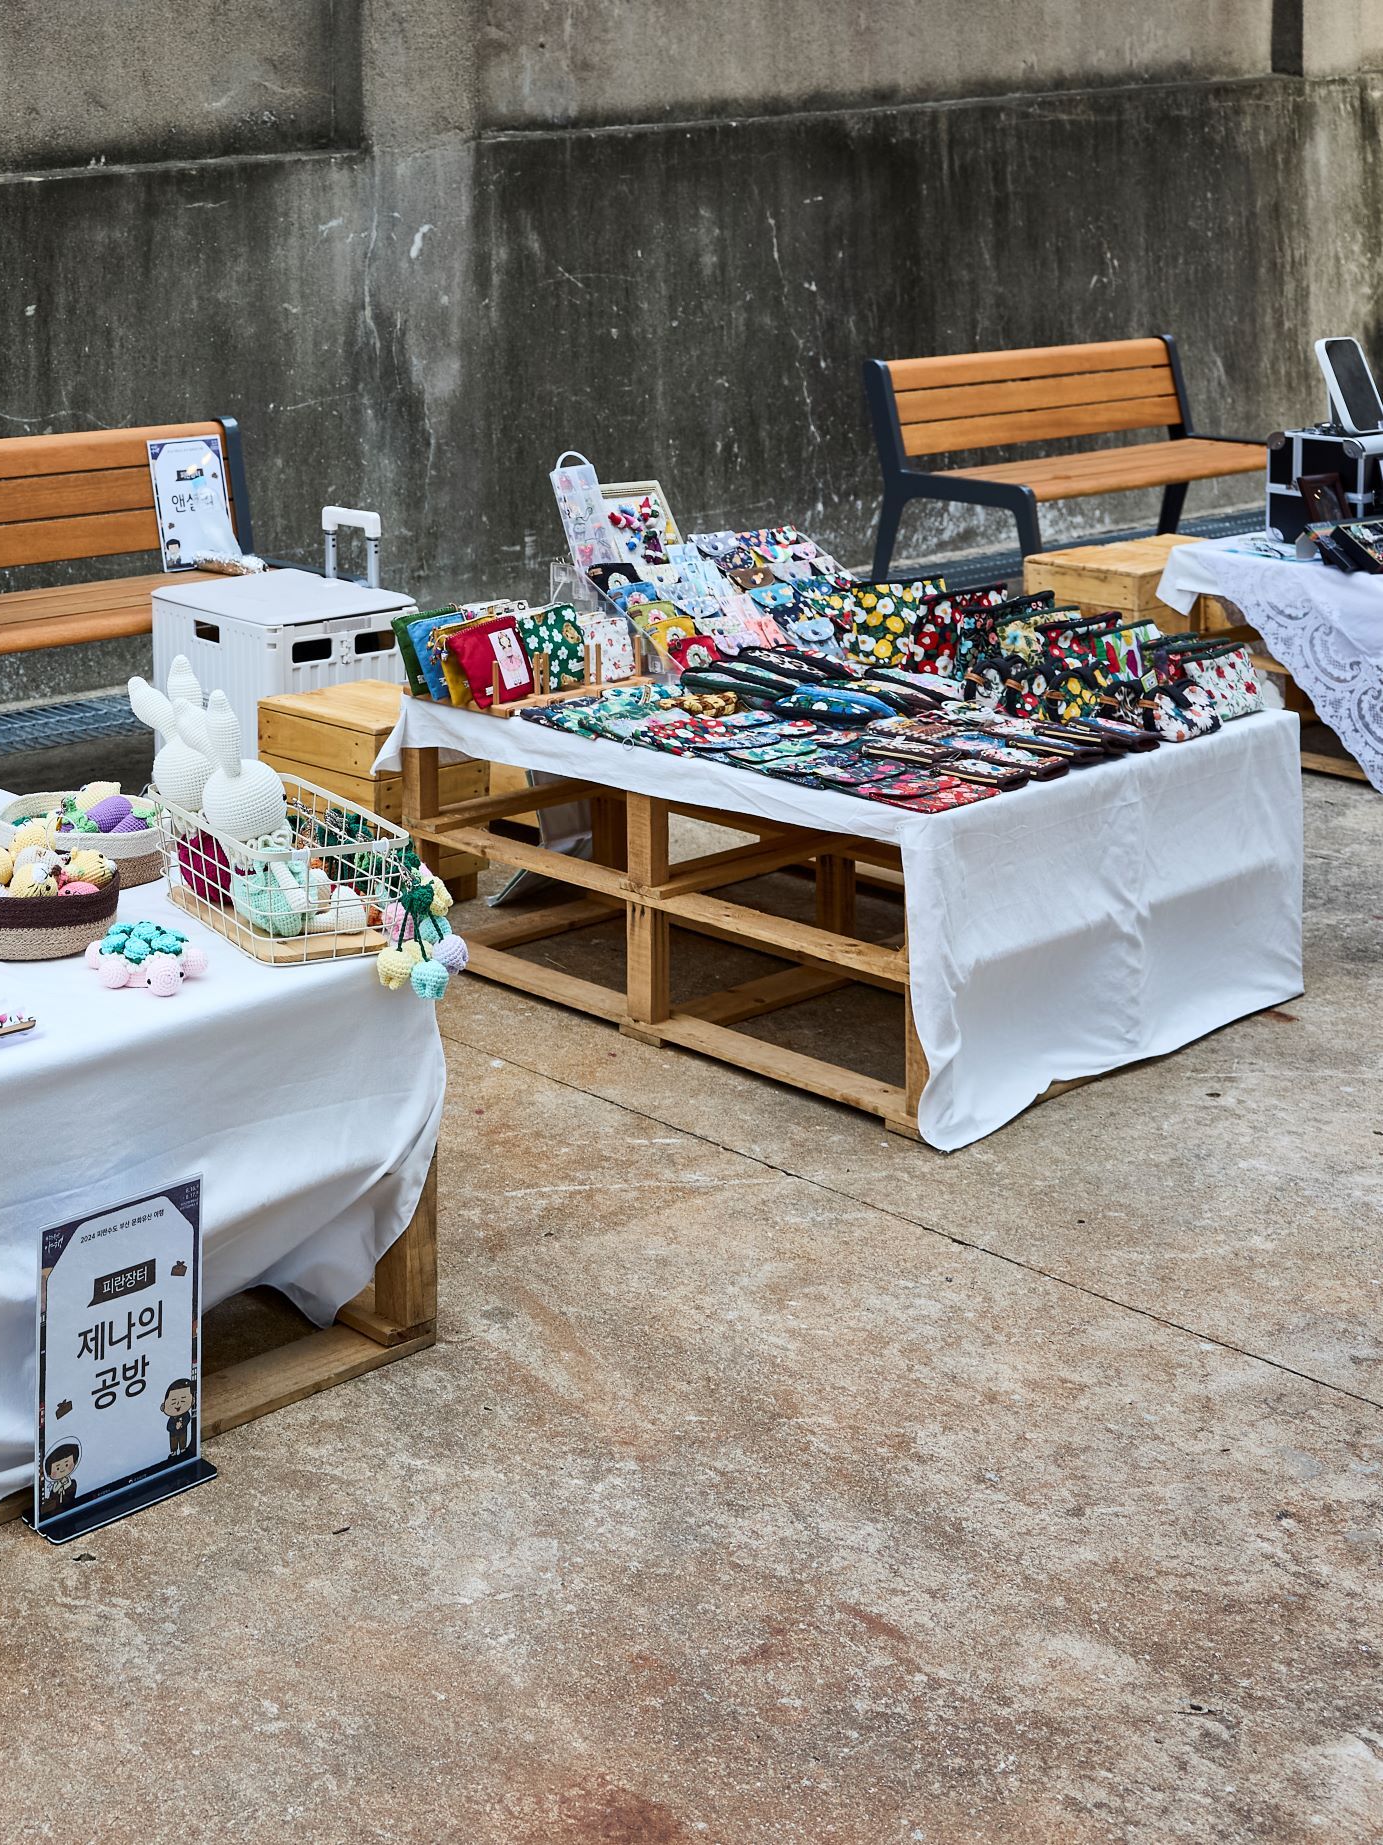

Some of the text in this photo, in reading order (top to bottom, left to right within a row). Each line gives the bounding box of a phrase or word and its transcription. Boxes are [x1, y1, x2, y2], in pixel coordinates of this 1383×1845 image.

[80, 1233, 96, 1244] 2024
[96, 1225, 118, 1237] 피란수도
[119, 1220, 130, 1230] 부산
[102, 1266, 148, 1294] 피란장터
[76, 1299, 163, 1361] 제나의
[91, 1354, 150, 1410] 공방
